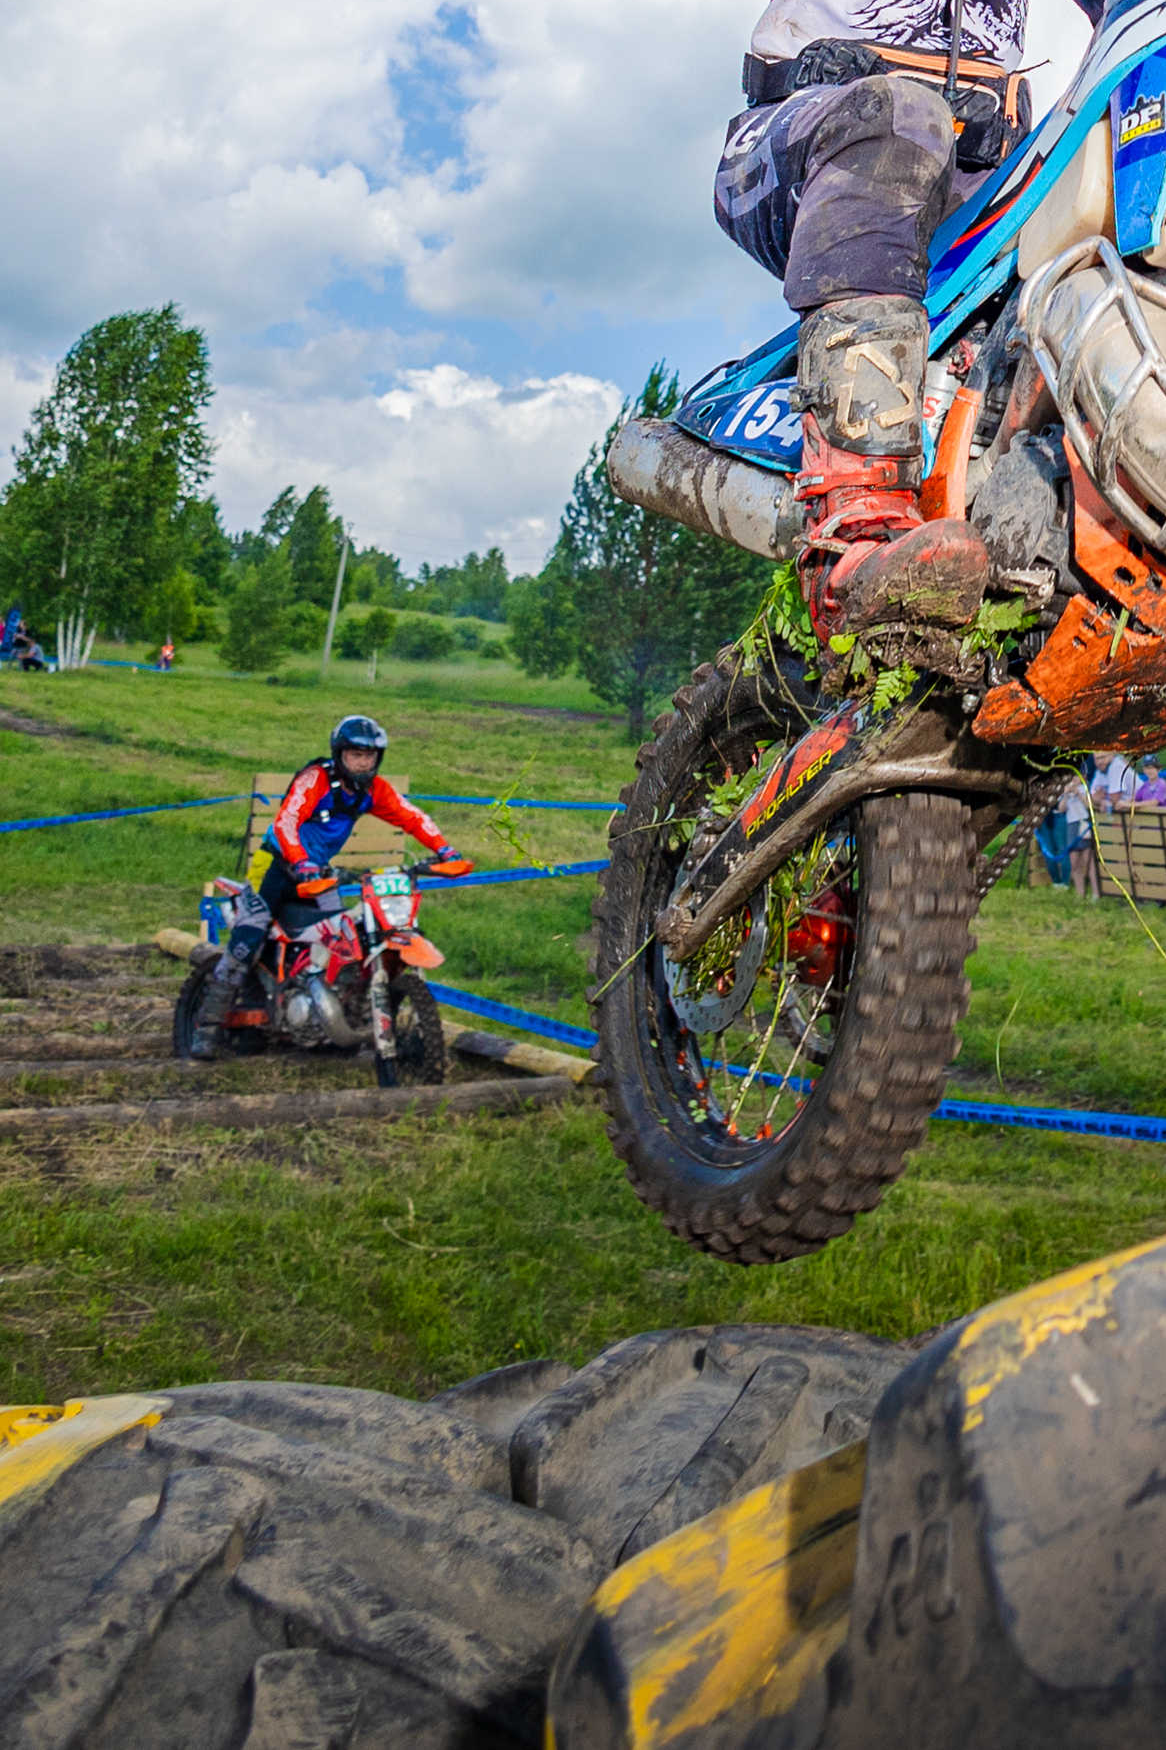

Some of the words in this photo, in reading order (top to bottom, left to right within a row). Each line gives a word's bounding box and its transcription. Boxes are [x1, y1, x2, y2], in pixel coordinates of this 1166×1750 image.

[1121, 103, 1161, 135] DP
[723, 387, 804, 448] 154
[746, 748, 832, 840] PROFILTER
[374, 879, 410, 895] 314
